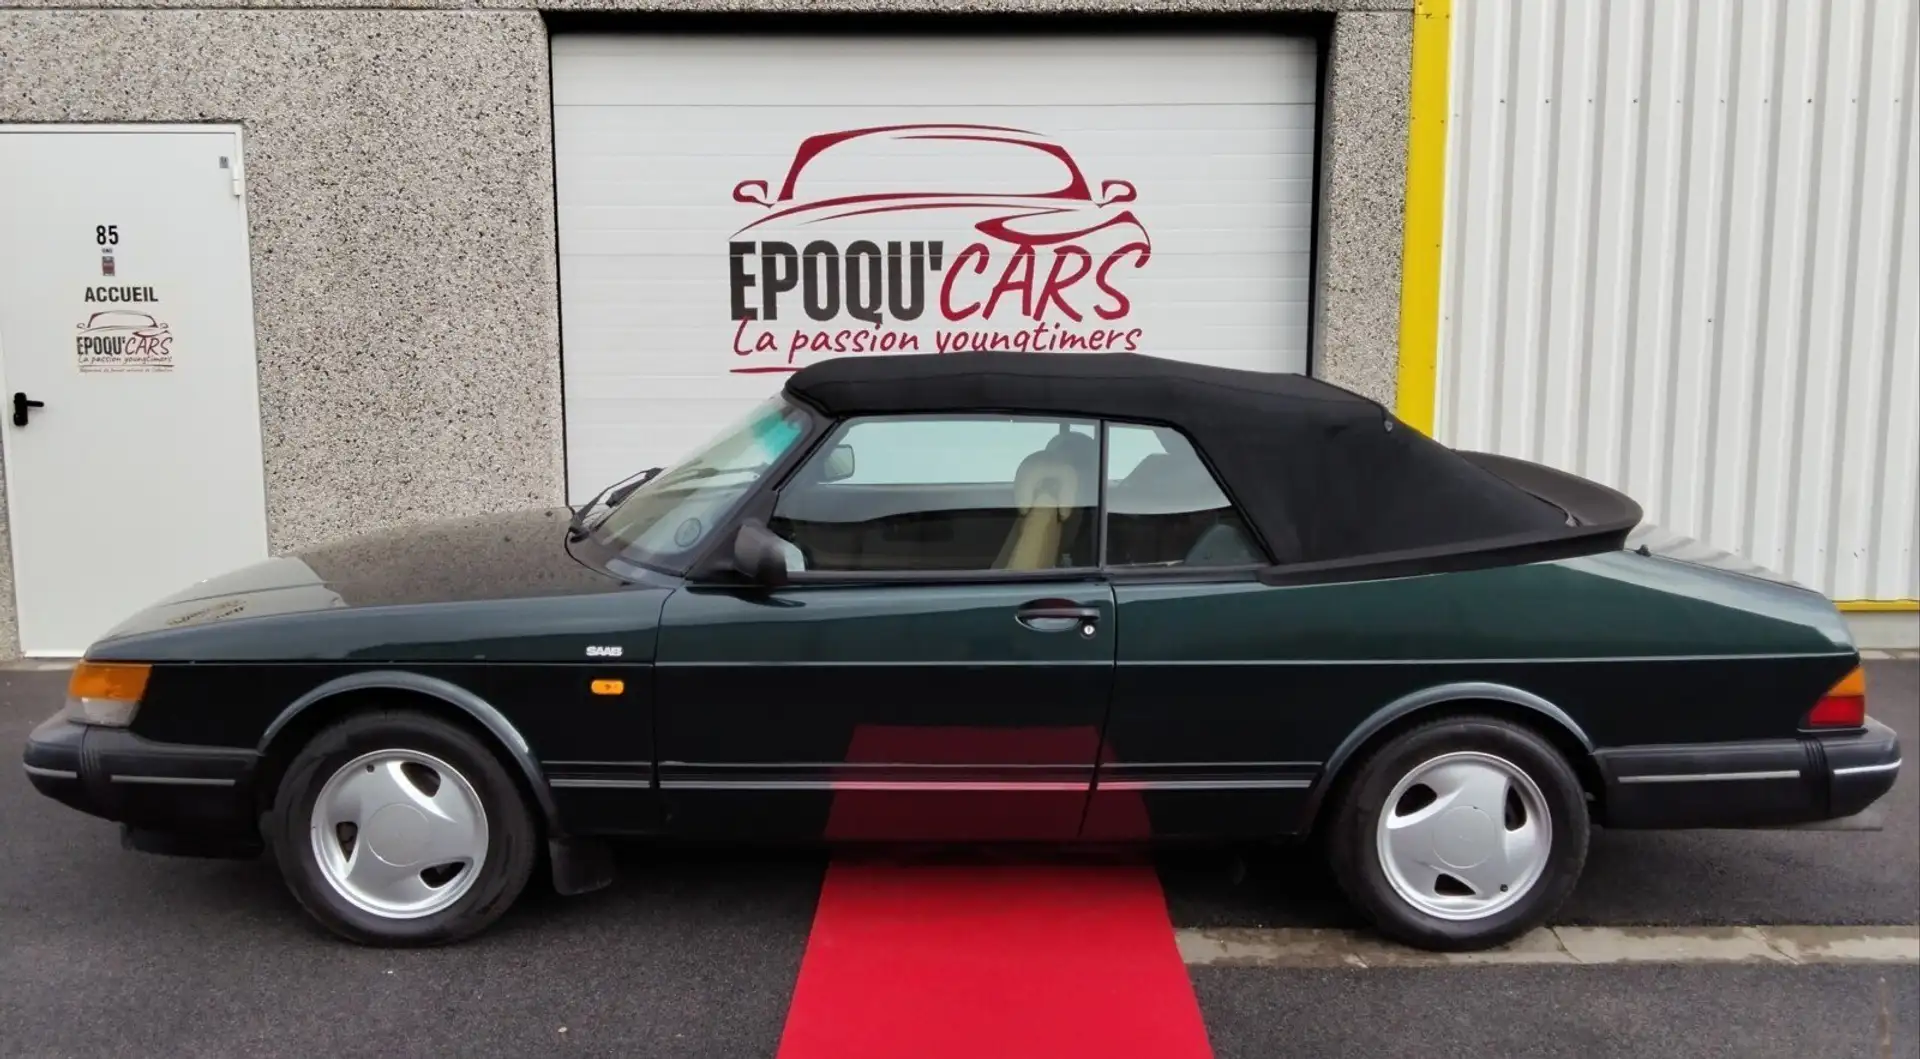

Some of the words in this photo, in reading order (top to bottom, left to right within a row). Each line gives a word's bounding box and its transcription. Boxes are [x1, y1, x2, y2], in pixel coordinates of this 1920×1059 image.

[96, 225, 119, 245] 85
[729, 240, 1151, 324] EPOQU'CARS
[84, 286, 159, 302] ACCUEIL
[732, 315, 778, 356] La
[788, 322, 919, 364] passion
[936, 322, 1143, 354] youngtimers
[91, 355, 121, 364] passion
[586, 646, 623, 656] SAAB
